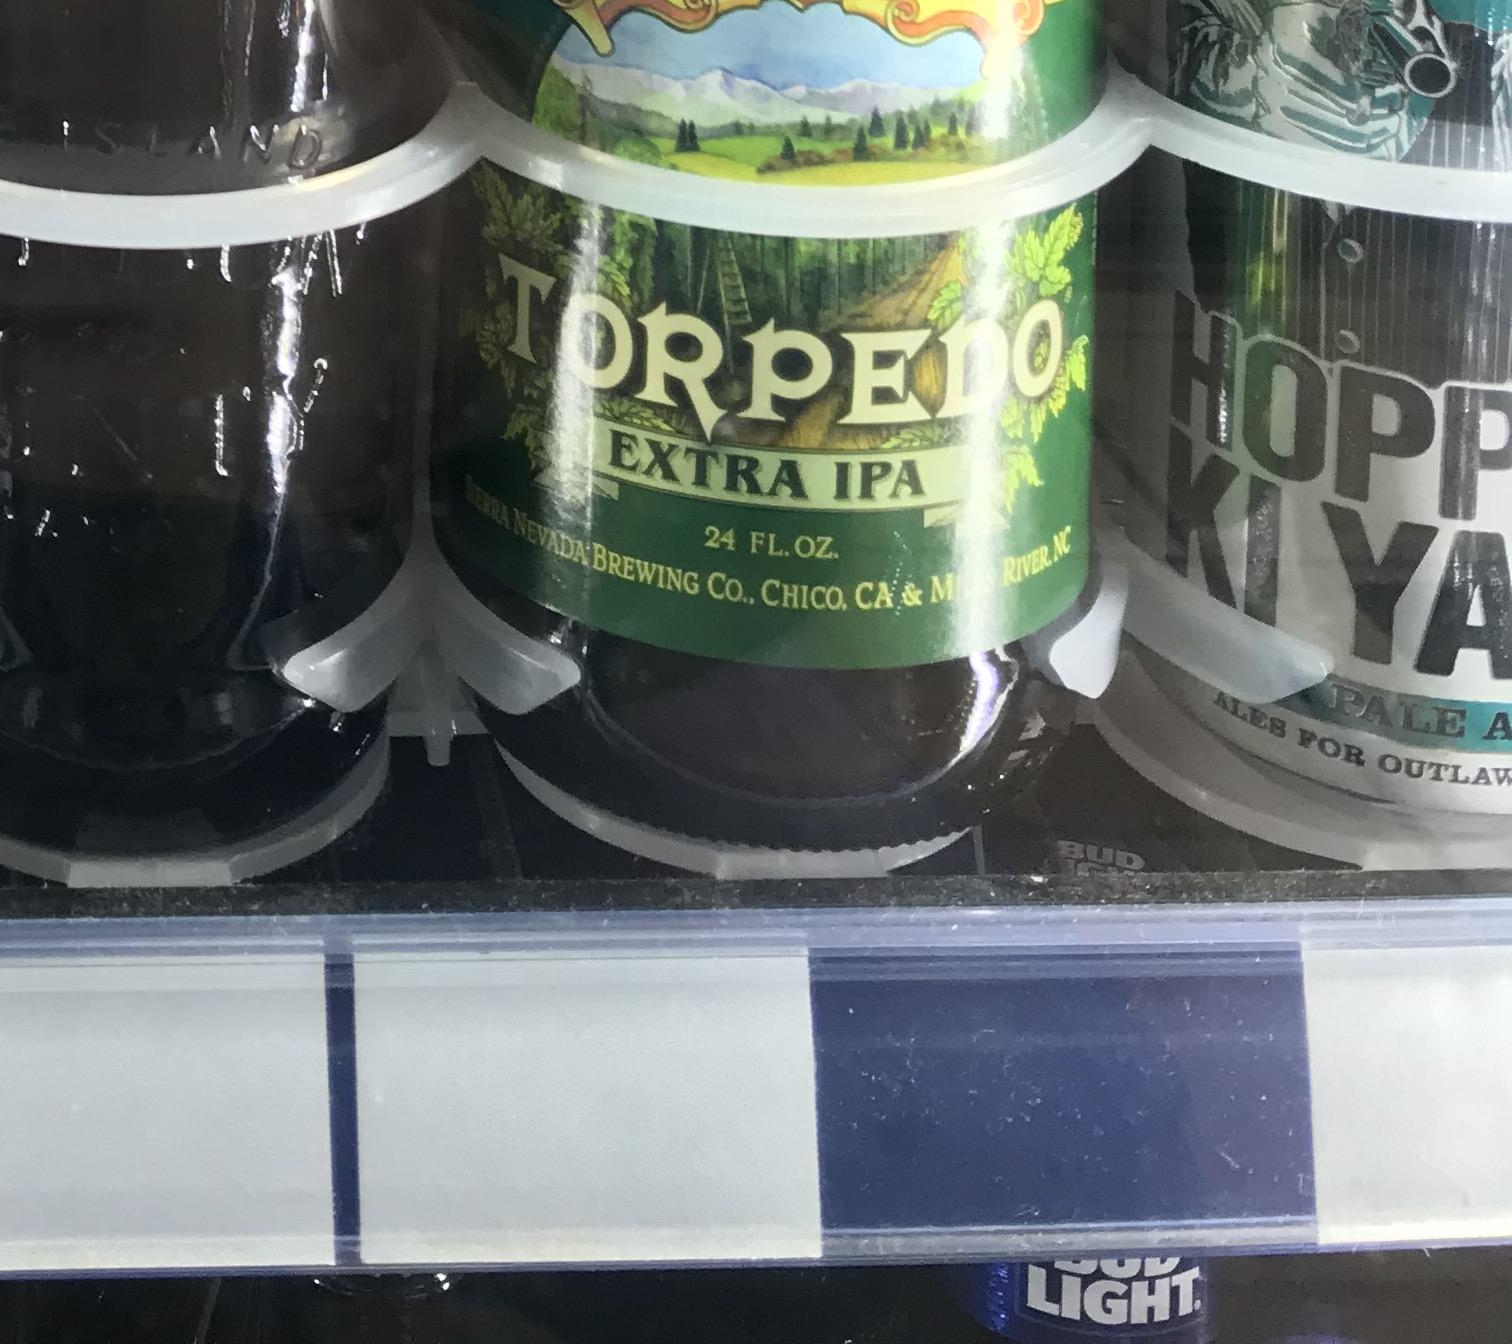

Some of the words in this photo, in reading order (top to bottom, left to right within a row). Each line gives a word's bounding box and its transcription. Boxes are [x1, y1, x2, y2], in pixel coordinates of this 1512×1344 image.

[497, 253, 1063, 441] TORPEDO
[1171, 288, 1512, 521] HOPP
[609, 428, 808, 500] EXTRA
[833, 458, 926, 501] IPA
[591, 541, 700, 595] BREWING
[761, 579, 848, 611] CHICO,
[855, 581, 893, 610] CA
[901, 583, 923, 607] &
[704, 525, 736, 551] 24
[750, 530, 788, 557] FL.
[794, 535, 840, 560] OZ.
[1322, 501, 1512, 680] YA
[1212, 690, 1287, 738] ALES
[1297, 727, 1366, 767] FOR
[1377, 753, 1512, 787] OUTLAW
[1331, 680, 1467, 739] PALE
